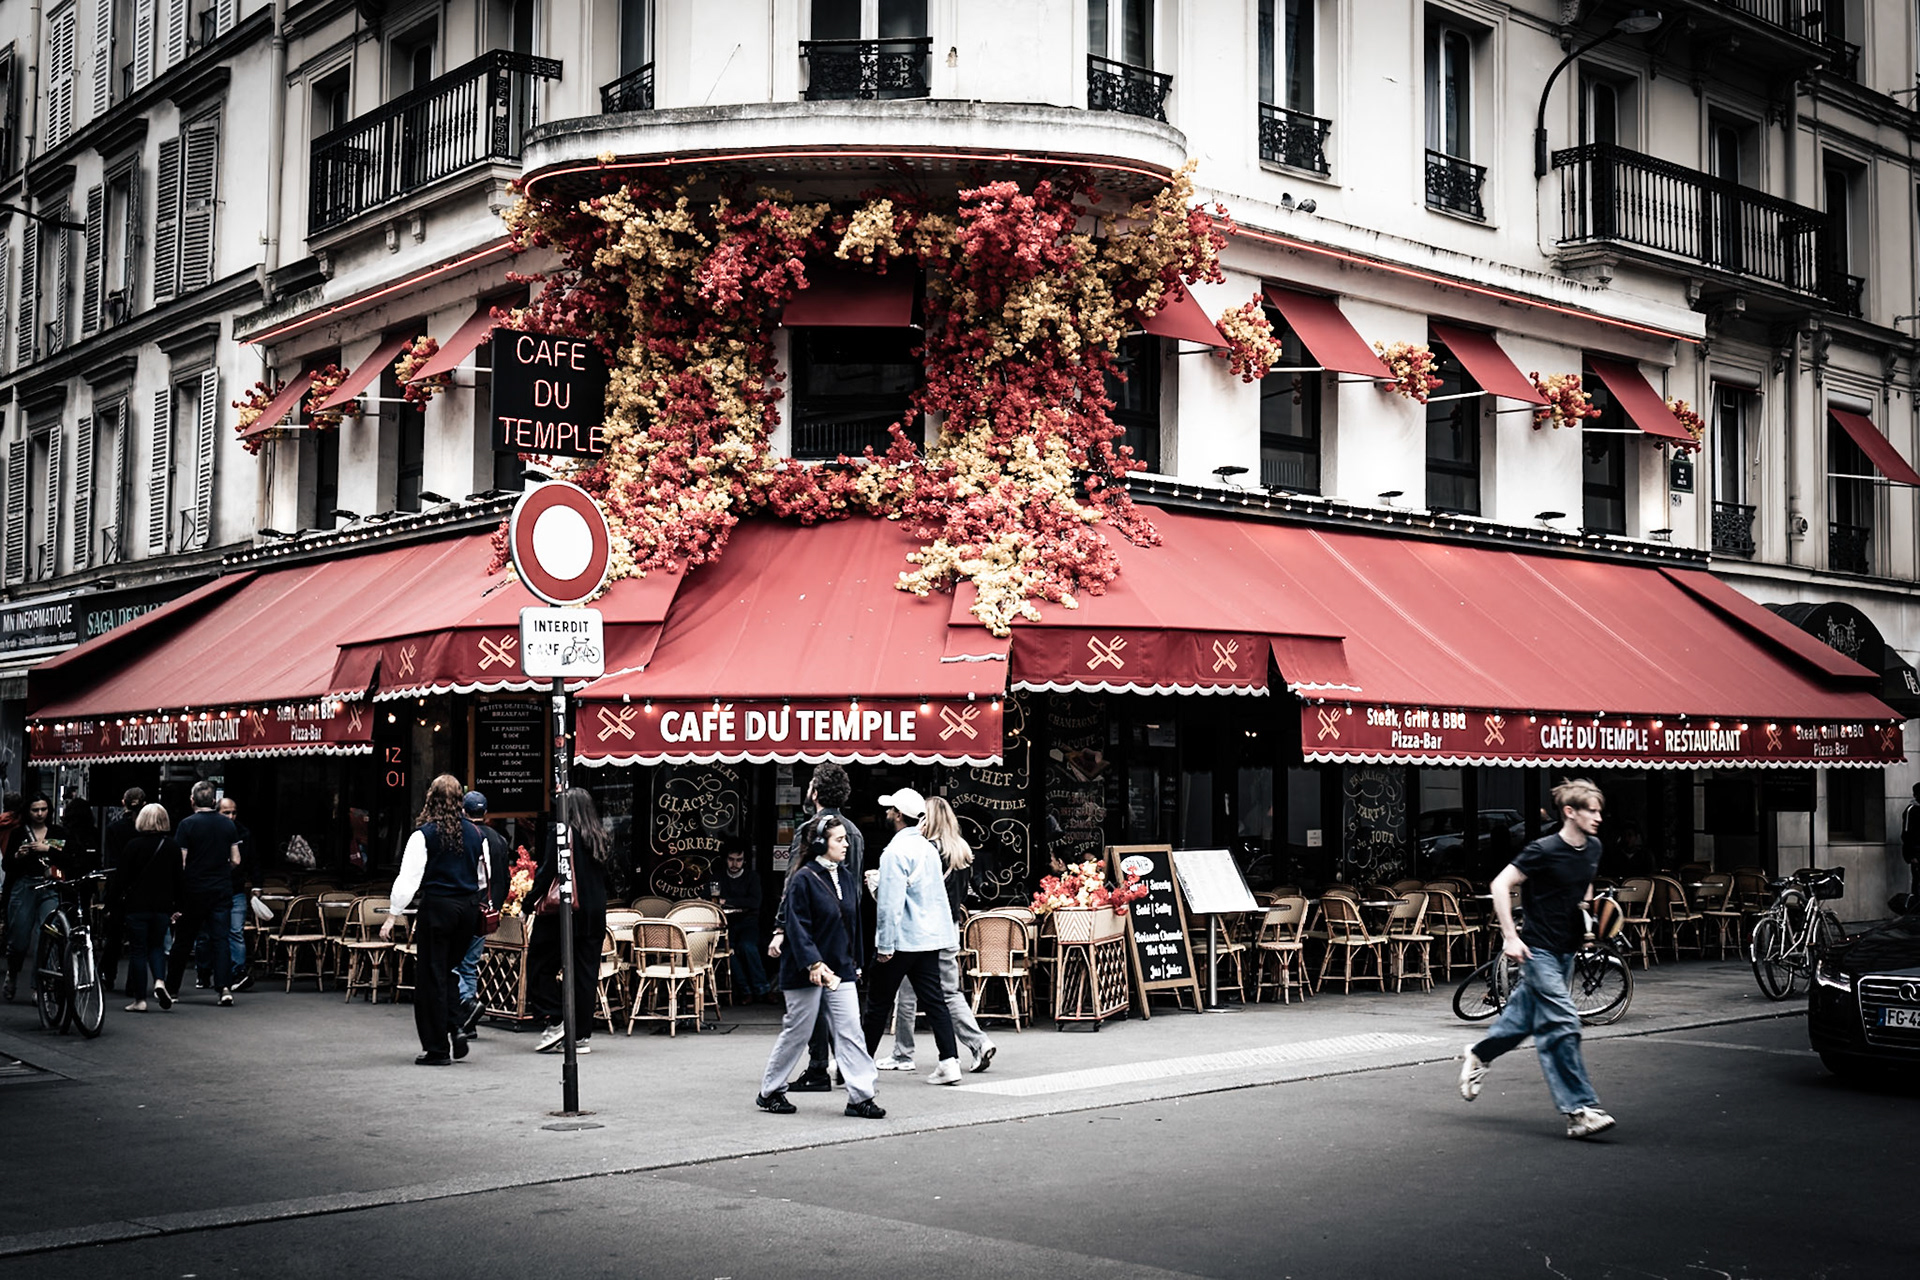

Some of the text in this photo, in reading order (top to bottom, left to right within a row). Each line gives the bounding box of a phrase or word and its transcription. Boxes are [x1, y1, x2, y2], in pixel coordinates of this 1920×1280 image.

[517, 335, 586, 371] CAFE
[535, 379, 571, 409] DU
[498, 416, 604, 454] TEMPLE
[16, 604, 72, 629] INFORMATIQUE
[534, 620, 589, 633] INTERDIT
[660, 704, 917, 743] CAFÉ DU TEMPLE
[1366, 708, 1467, 730] Steak, Grill & BBQ
[138, 724, 150, 746] DU
[150, 722, 178, 744] TEMPLE
[187, 718, 241, 743] RESTAURANT
[290, 723, 322, 741] Pizza-Bar
[1540, 720, 1741, 752] CAFÉ DU TEMPLE RESTAURANT
[1814, 742, 1849, 756] Pizza-Bar
[969, 769, 1014, 787] CHEF
[658, 791, 714, 813] GLACES
[950, 793, 1027, 811] SUSCEPTIBLE
[667, 836, 726, 856] SORBET
[656, 879, 705, 898] CAPPUCC
